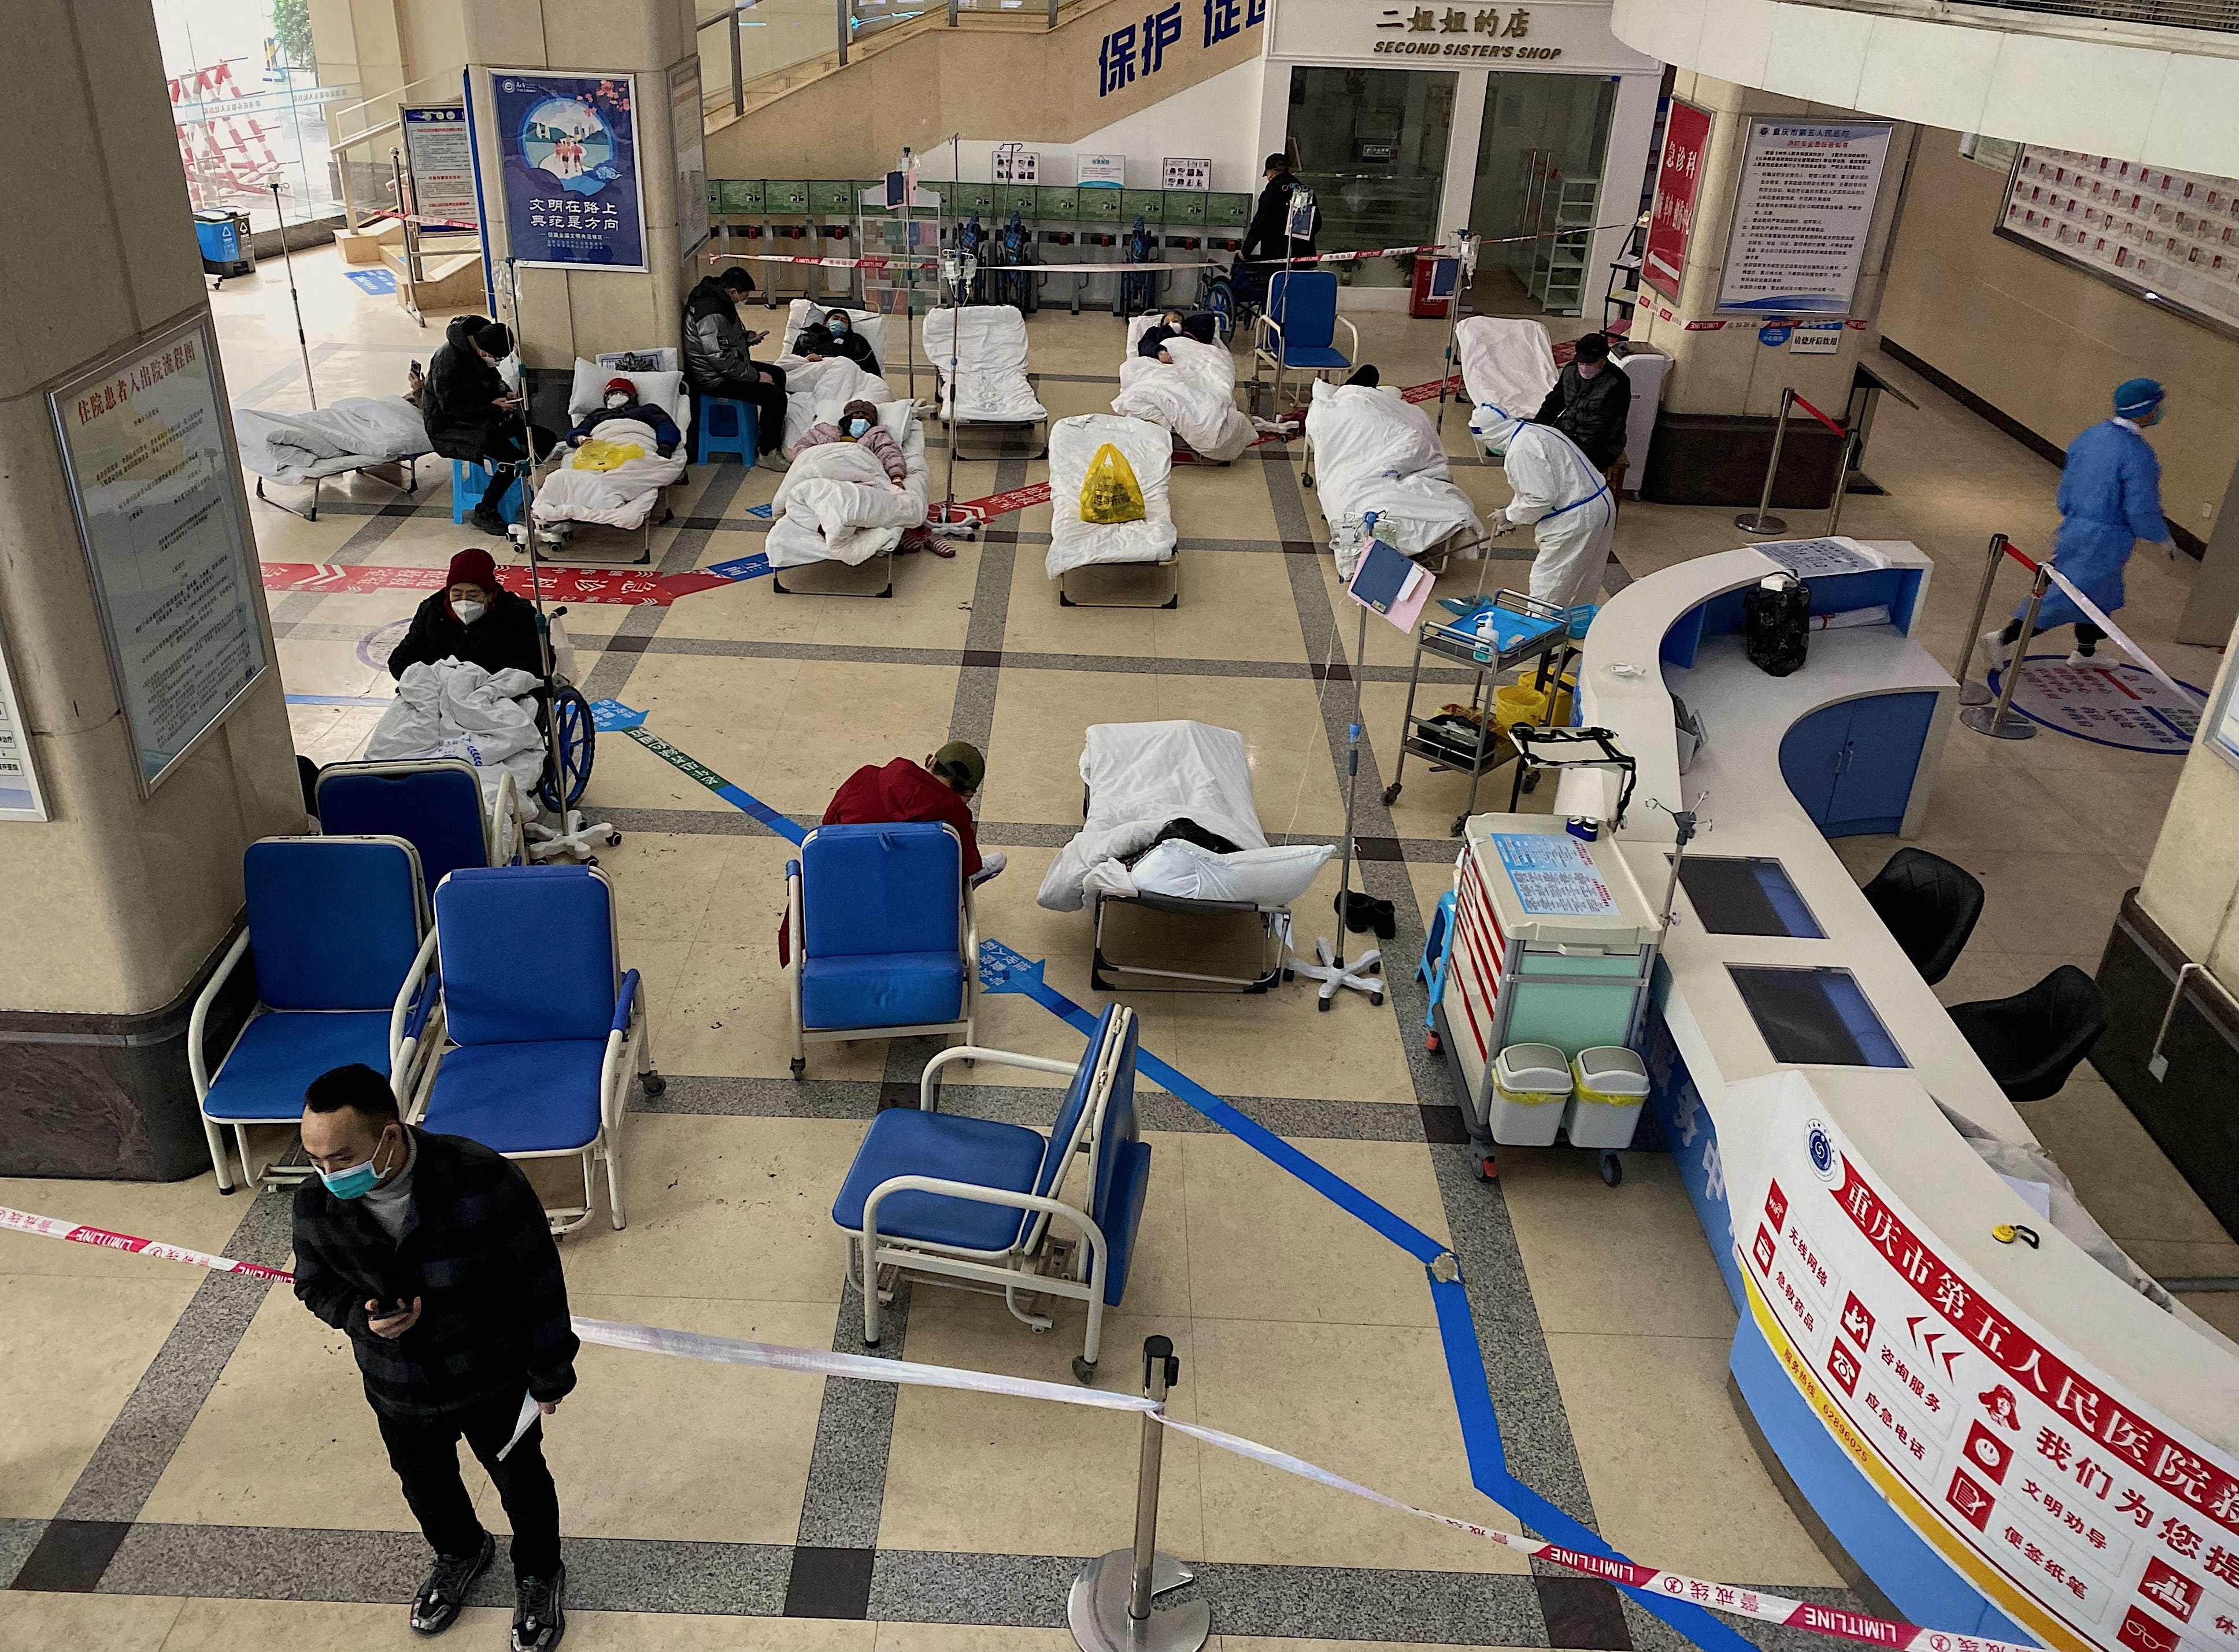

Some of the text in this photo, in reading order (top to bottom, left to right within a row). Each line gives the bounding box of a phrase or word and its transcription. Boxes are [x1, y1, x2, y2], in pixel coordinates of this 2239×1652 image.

[1376, 6, 1530, 38] 二姐姐的店
[1099, 2, 1182, 97] 保护
[1374, 41, 1562, 60] SECOND SISTER'S SHOP
[1666, 140, 1697, 179] 急诊科
[530, 198, 618, 214] 文明在路上
[531, 215, 619, 231] 典范是方向
[1794, 336, 1837, 346] 请烧开后饮用
[78, 340, 195, 426] 住院患者入出院流程图
[521, 575, 657, 595] 急诊科
[76, 1227, 134, 1252] LIMITLINE
[1789, 1225, 1829, 1288] 无线网络
[1776, 1271, 1814, 1332] 急救药品
[1881, 1344, 1941, 1413] 咨询服务
[1823, 1404, 1868, 1462] 62896025
[1864, 1392, 1926, 1461] 应急电话
[2022, 1479, 2107, 1550] 文明劝导
[1549, 1546, 1635, 1583] LIMITLINE
[2004, 1525, 2088, 1599] 便签纸笔
[1691, 1579, 1759, 1614] 警戒线
[1805, 1606, 1898, 1642] LIMITLINE
